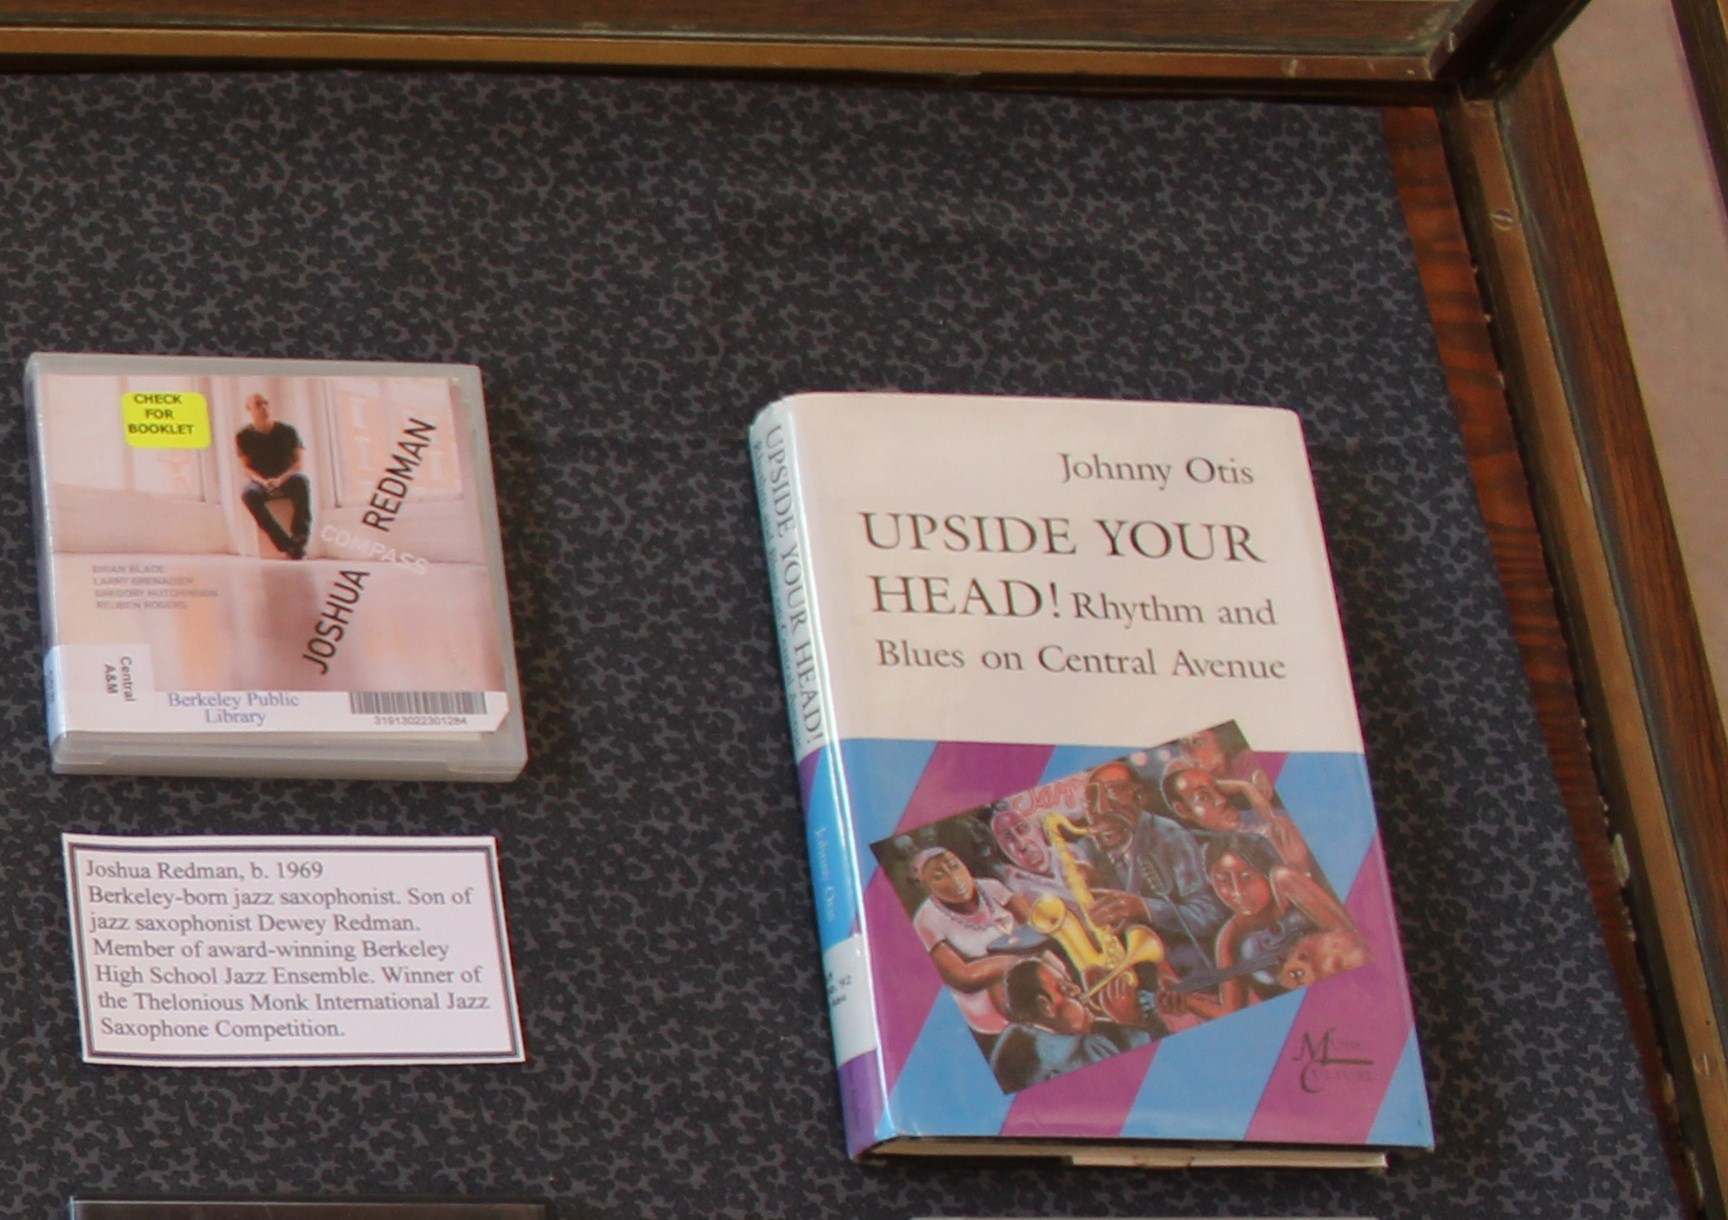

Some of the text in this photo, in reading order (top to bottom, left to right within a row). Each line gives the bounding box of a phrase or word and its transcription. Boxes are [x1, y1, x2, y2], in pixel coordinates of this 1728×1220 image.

[134, 394, 182, 405] CHECK
[145, 409, 174, 419] FOR
[128, 424, 195, 435] BOOKLET
[1060, 453, 1254, 488] Johnny Otis
[303, 418, 436, 674] JOSHUA REDMAN
[320, 526, 427, 574] COMPASS
[857, 512, 1265, 563] UPSIDE YOUR
[868, 575, 1277, 628] HEAD! Rhythm and
[876, 639, 1286, 680] Blues on Central Avenue
[169, 693, 299, 708] Berkeley Public
[205, 709, 266, 726] Library
[85, 859, 324, 882] Joshua Redman, b. 1969
[100, 1016, 346, 1043] Saxophone Competition.
